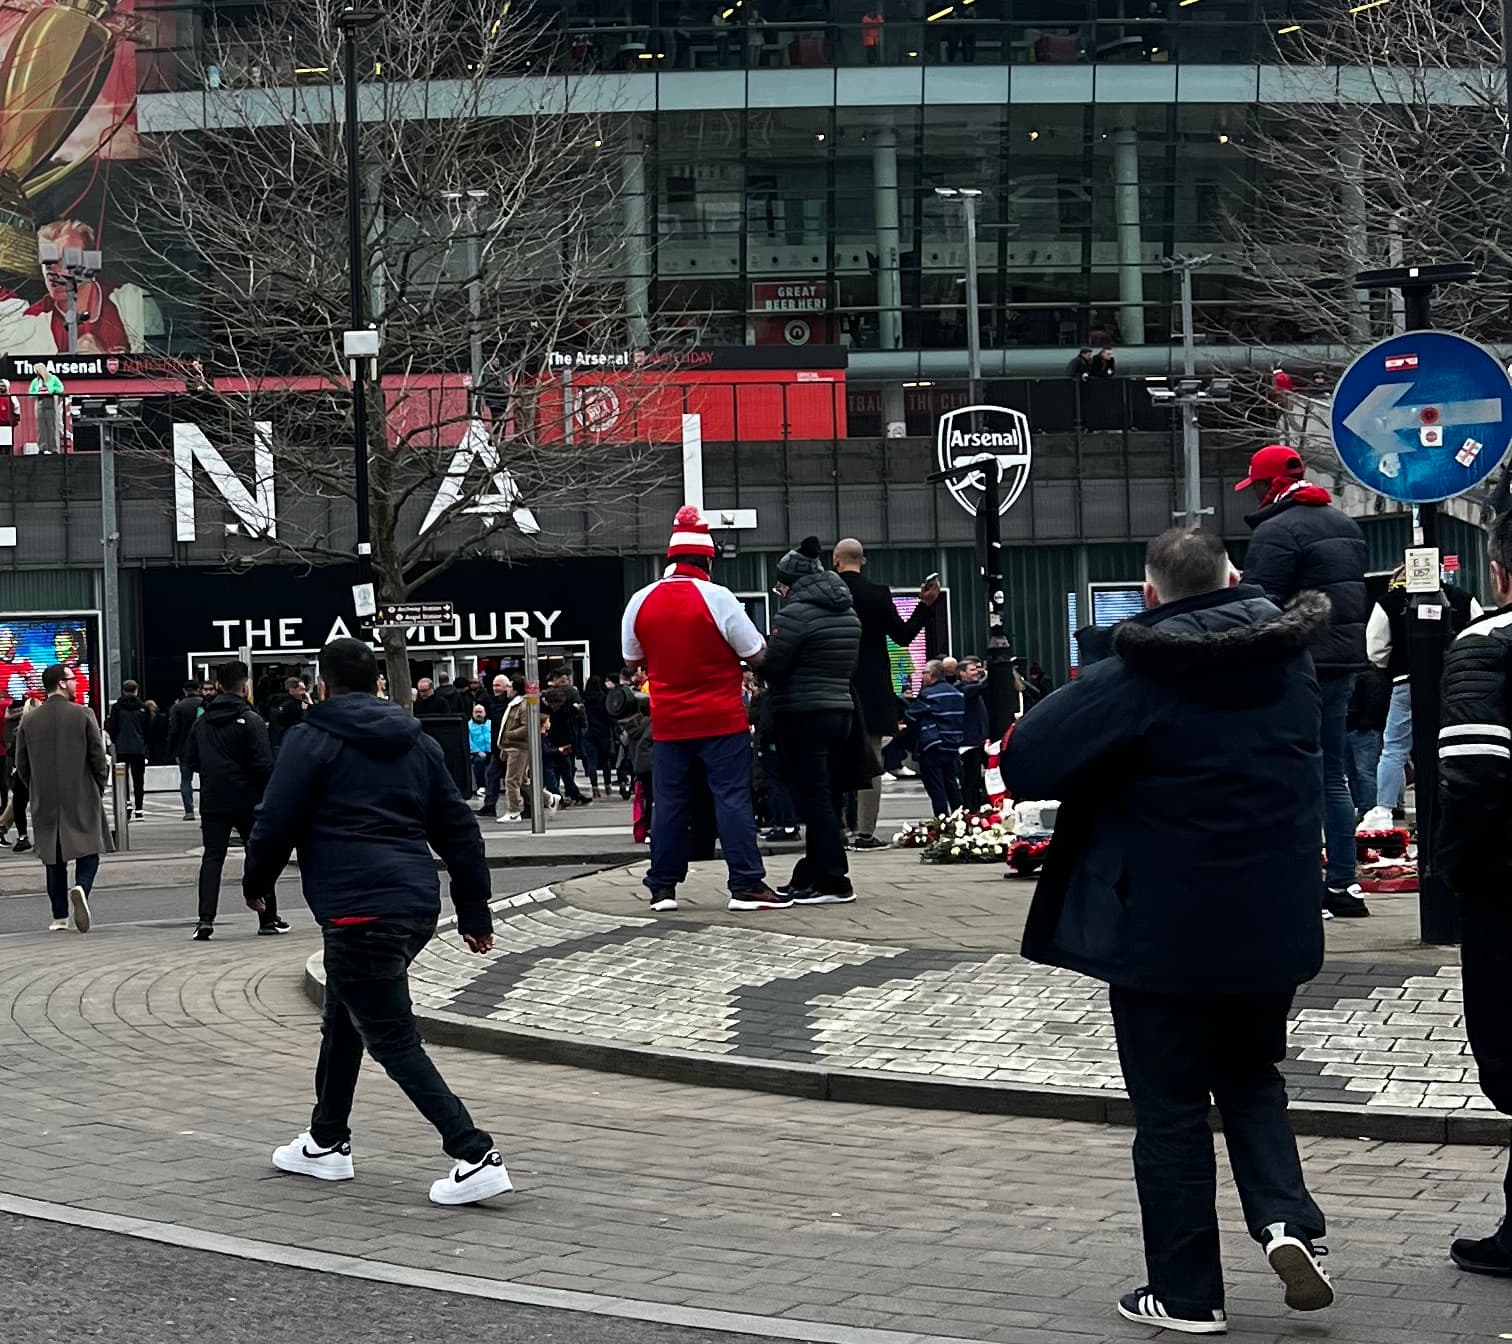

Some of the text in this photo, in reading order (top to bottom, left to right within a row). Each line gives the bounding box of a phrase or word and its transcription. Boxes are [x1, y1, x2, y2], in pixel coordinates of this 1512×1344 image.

[777, 286, 817, 297] GREAT
[765, 299, 795, 310] BEER
[548, 352, 572, 366] The
[576, 350, 629, 366] Arsenal
[46, 359, 102, 374] Arsenal
[951, 429, 1019, 447] Arsenal
[213, 610, 562, 648] THE AOURY
